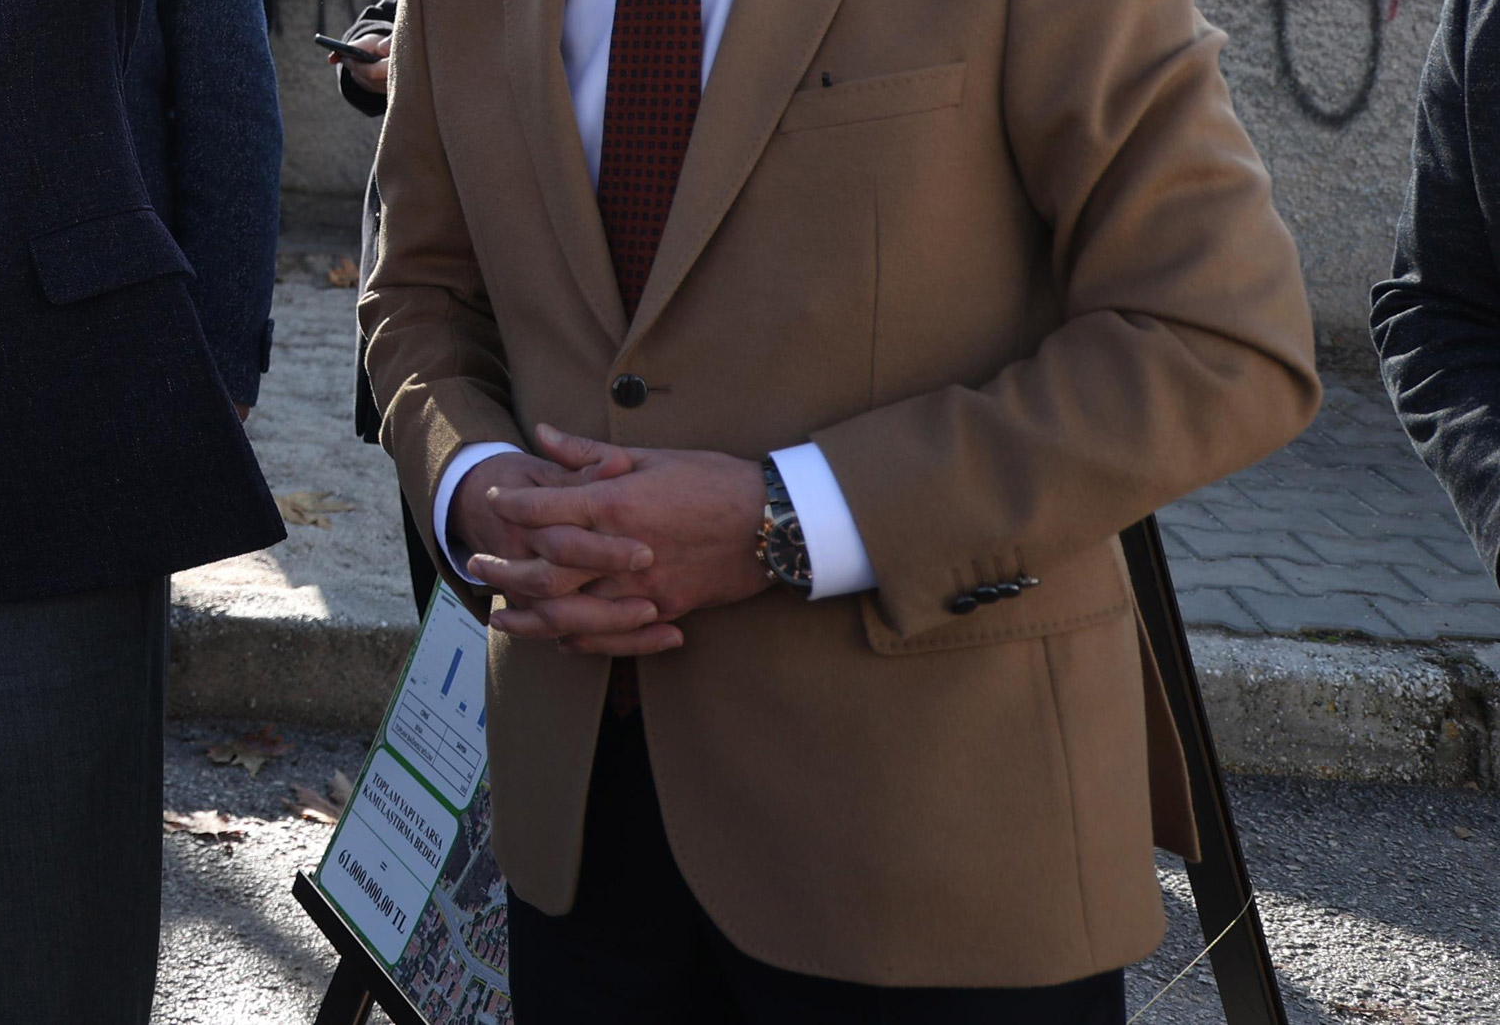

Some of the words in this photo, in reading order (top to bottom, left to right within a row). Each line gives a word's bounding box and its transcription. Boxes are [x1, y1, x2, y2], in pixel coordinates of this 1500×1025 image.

[361, 783, 414, 844] KAMULAŞTIRMA
[413, 836, 441, 870] BEDELİ
[372, 771, 400, 804] TOPLAM
[399, 798, 417, 821] YAPI
[413, 812, 426, 829] VE
[422, 824, 443, 851] ARSA
[337, 848, 395, 918] 61.000.000,00
[391, 905, 408, 935] TL
